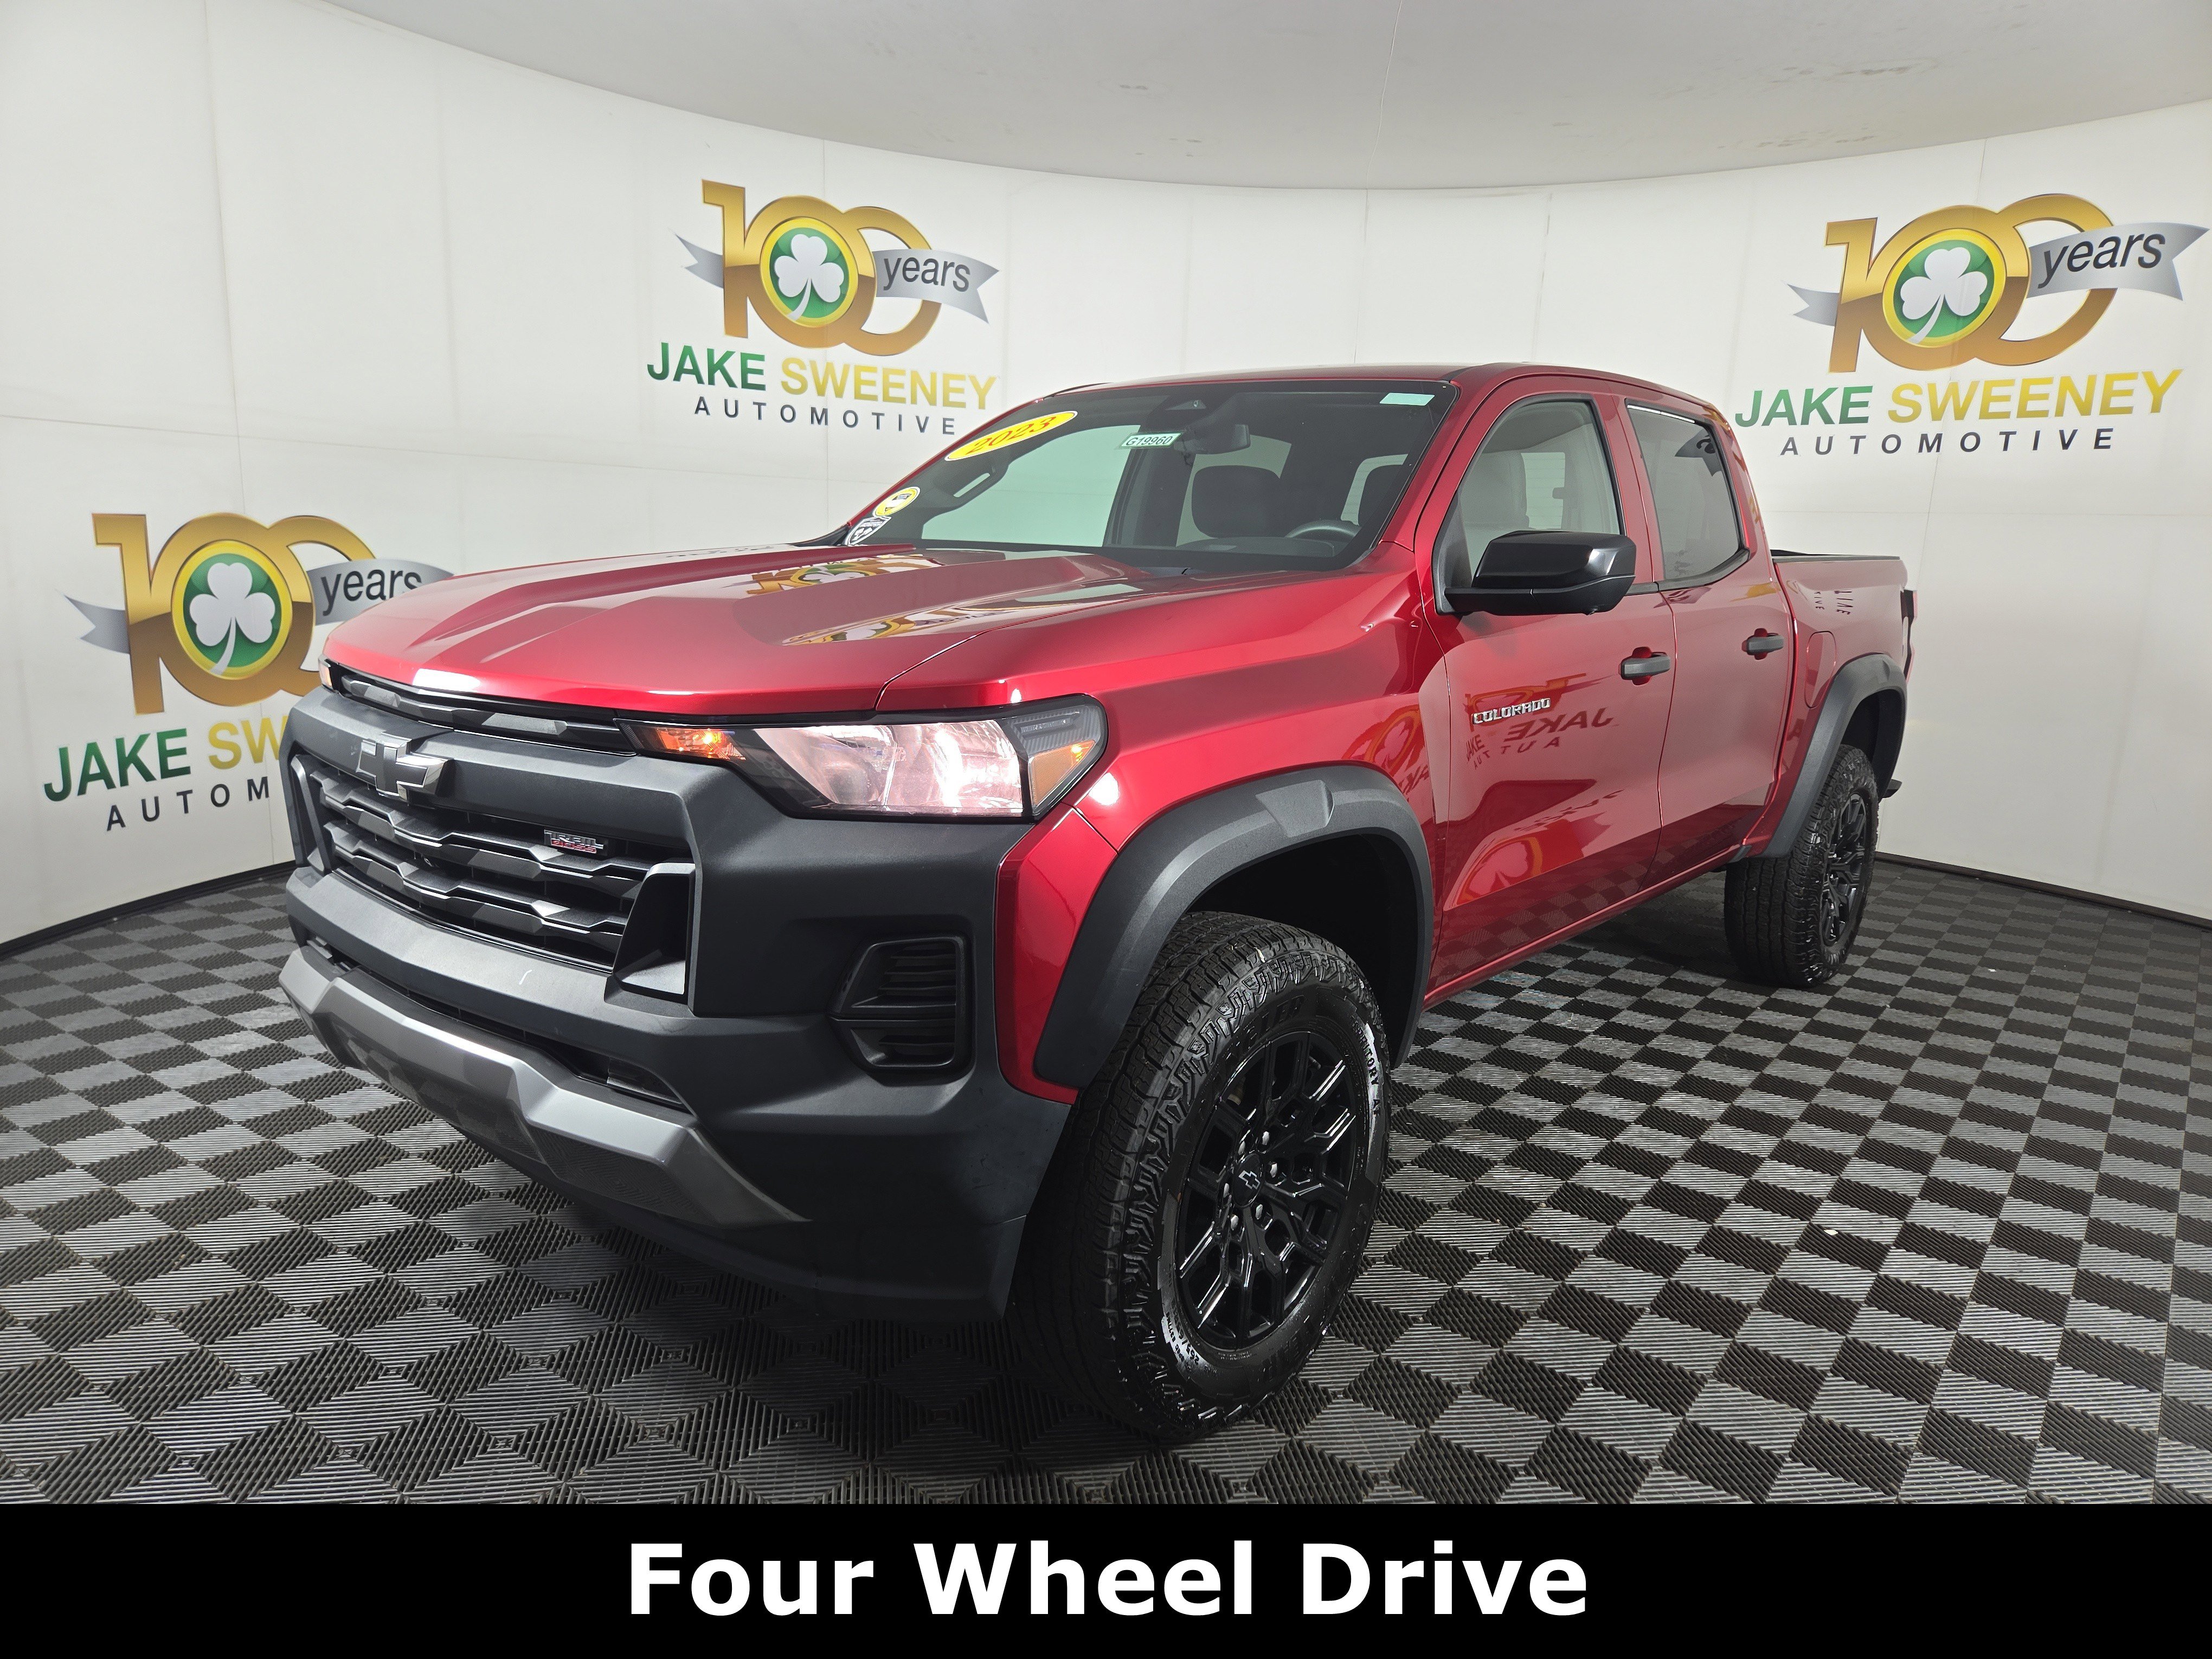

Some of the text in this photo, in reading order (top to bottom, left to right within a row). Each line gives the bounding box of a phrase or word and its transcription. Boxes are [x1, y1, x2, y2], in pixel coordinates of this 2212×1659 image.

[883, 254, 971, 293] years
[2037, 233, 2166, 289] years
[647, 342, 996, 410] JAKE SWEENEY
[695, 396, 955, 435] AUTOMOTIVE
[1734, 369, 2184, 427] JAKE SWEENEY
[965, 416, 1057, 455] 2023
[1126, 436, 1173, 446] G19960
[1780, 428, 2114, 456] AUTOMOTIVE
[321, 569, 422, 616] years
[1472, 697, 1551, 725] COLORADO
[44, 728, 191, 802] JAKE
